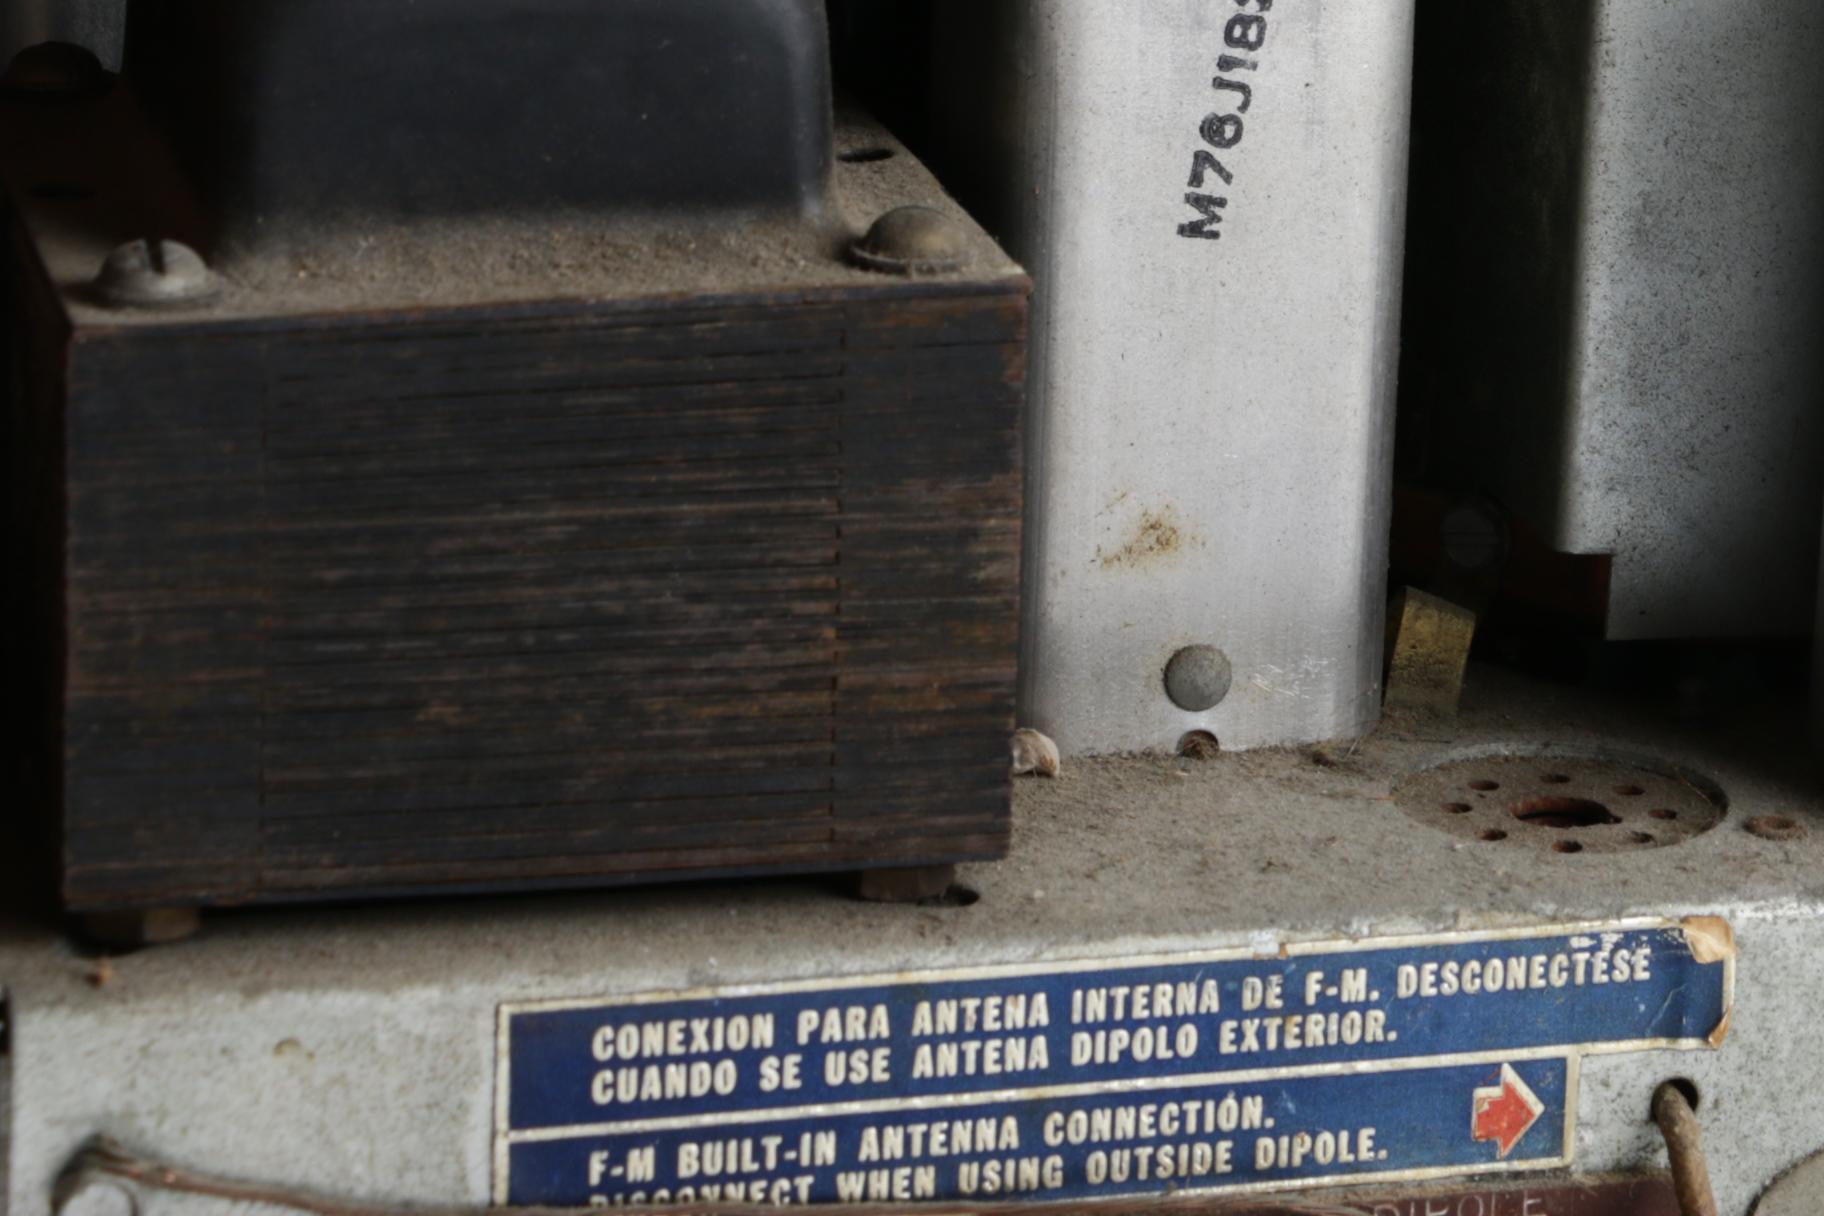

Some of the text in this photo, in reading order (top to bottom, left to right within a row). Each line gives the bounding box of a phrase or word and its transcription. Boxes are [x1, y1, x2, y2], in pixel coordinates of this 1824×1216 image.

[592, 1013, 774, 1061] CONEXION
[797, 1004, 890, 1045] PARA
[912, 991, 1049, 1037] ANTENA
[1071, 977, 1219, 1024] INTERNA
[1243, 974, 1284, 1011] DE
[1305, 968, 1380, 1005] F-M.
[591, 1010, 1397, 1105] CUANDO SE USE ANTENA DIPOLO EXTERIOR.
[589, 1147, 655, 1186] F-M
[678, 1130, 836, 1179] BUILT-IN
[859, 1116, 1019, 1163] ANTENNA
[836, 1166, 936, 1202] WHEN
[958, 1153, 1063, 1194] USING
[1086, 1137, 1232, 1183] OUTSIDE
[1255, 1128, 1388, 1171] DIPOLE.
